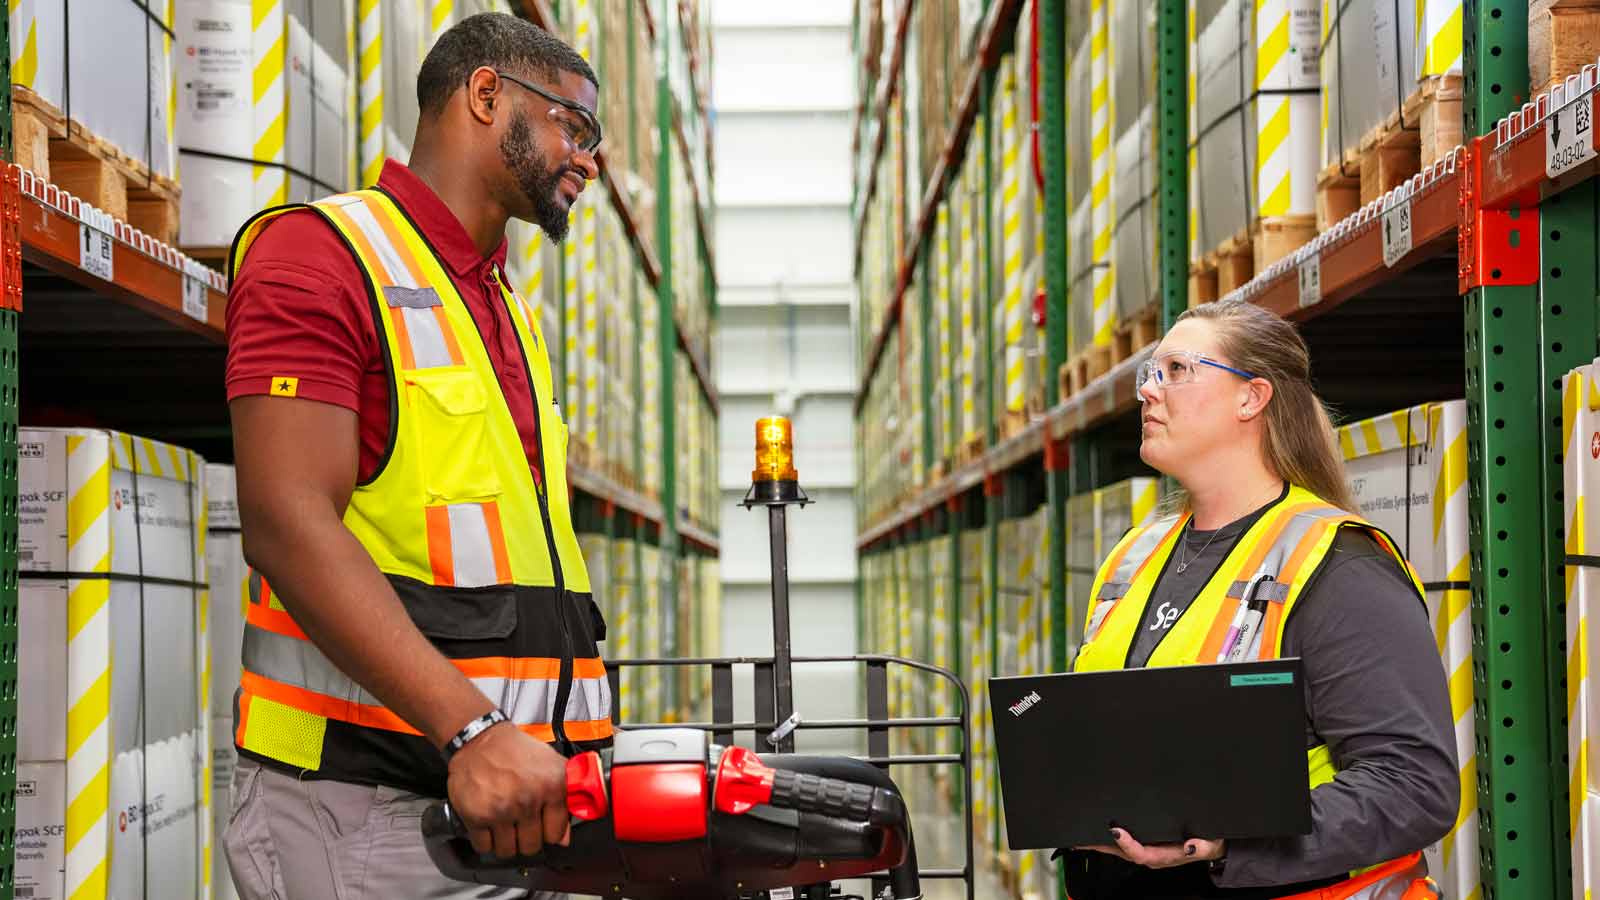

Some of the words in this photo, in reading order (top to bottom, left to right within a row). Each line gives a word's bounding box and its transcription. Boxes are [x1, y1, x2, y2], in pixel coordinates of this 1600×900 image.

[1551, 139, 1585, 170] 48-03-02
[20, 491, 40, 504] pak
[43, 491, 64, 502] SCF
[1150, 601, 1184, 630] Se
[1008, 690, 1041, 717] ThinkPad
[43, 825, 64, 837] SCF
